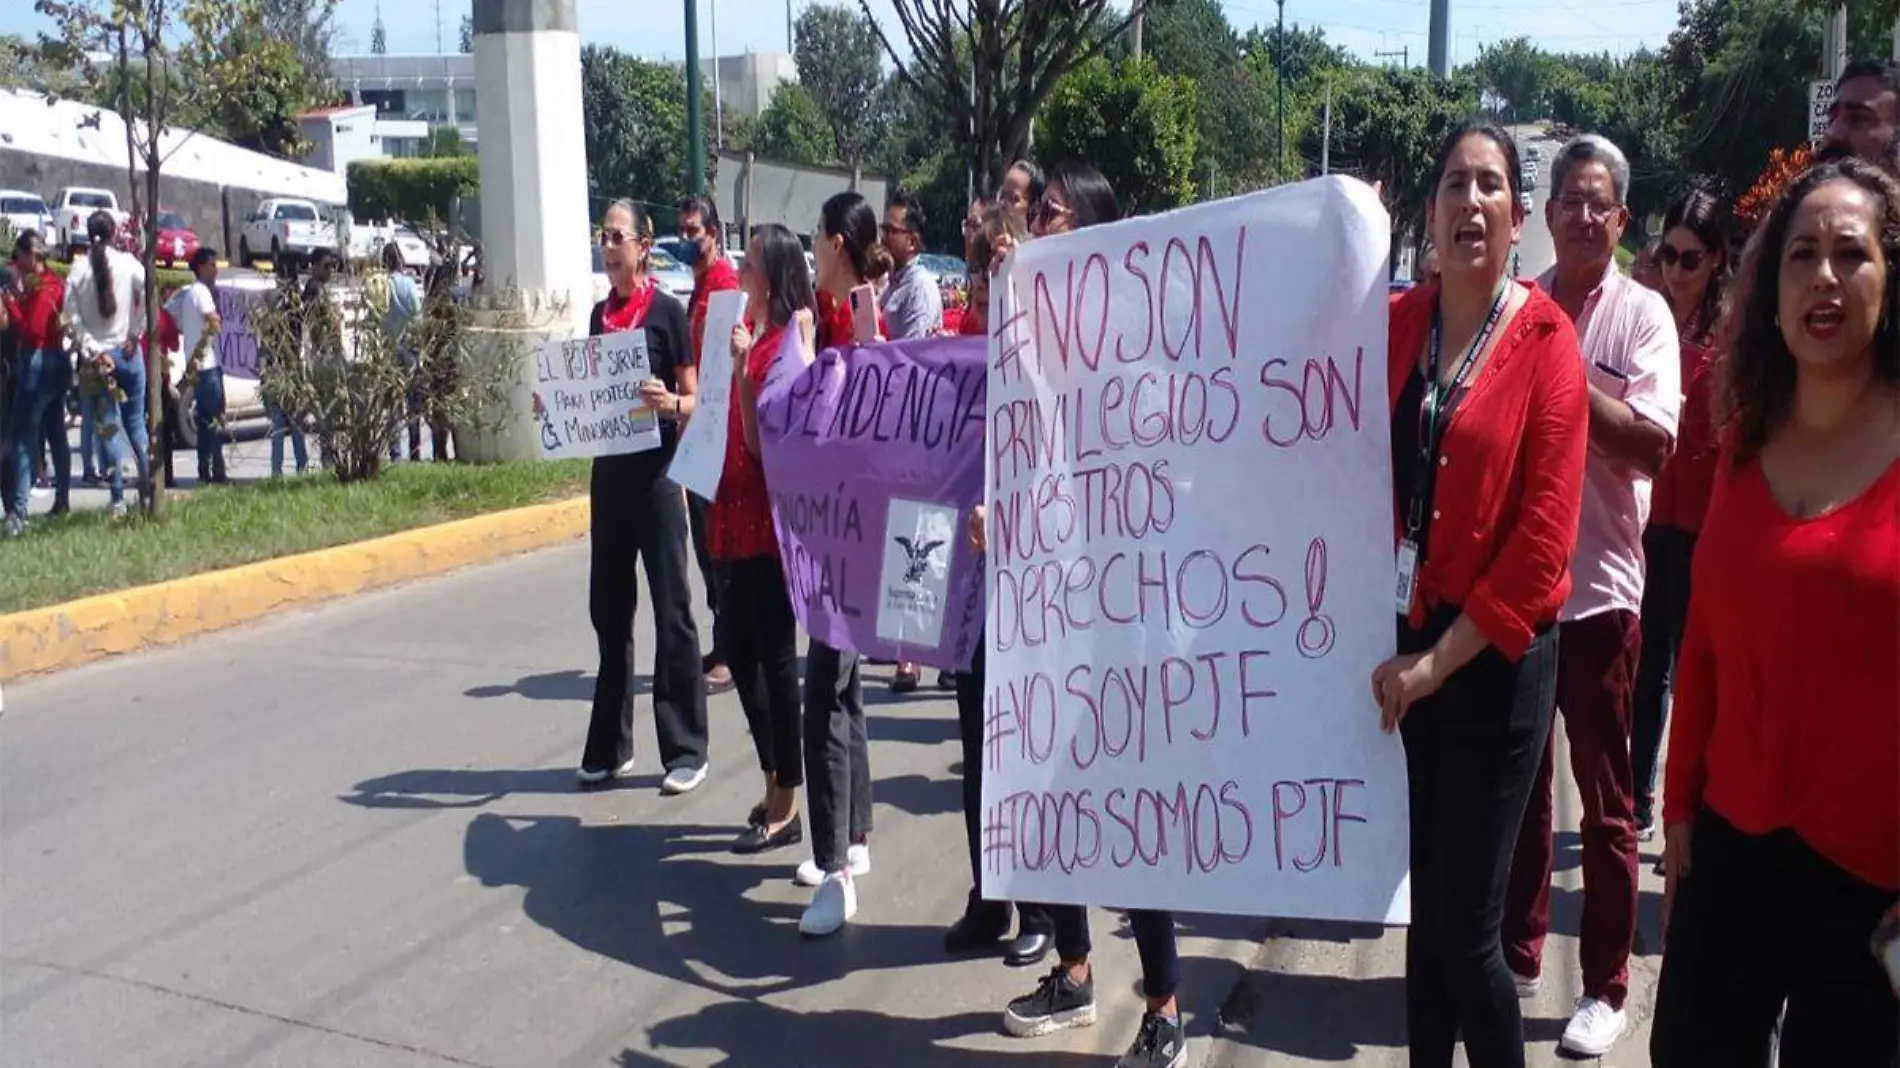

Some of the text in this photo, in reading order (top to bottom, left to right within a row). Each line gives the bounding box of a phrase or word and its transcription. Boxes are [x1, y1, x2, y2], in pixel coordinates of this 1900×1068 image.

[1817, 85, 1833, 98] ZO
[1115, 225, 1246, 362] SON
[562, 337, 603, 380] PJF
[1261, 346, 1364, 448] SON
[1065, 665, 1149, 770] SOY
[1160, 650, 1278, 744] PJF
[1104, 780, 1254, 876] SOMOS
[1272, 779, 1368, 872] PJF
